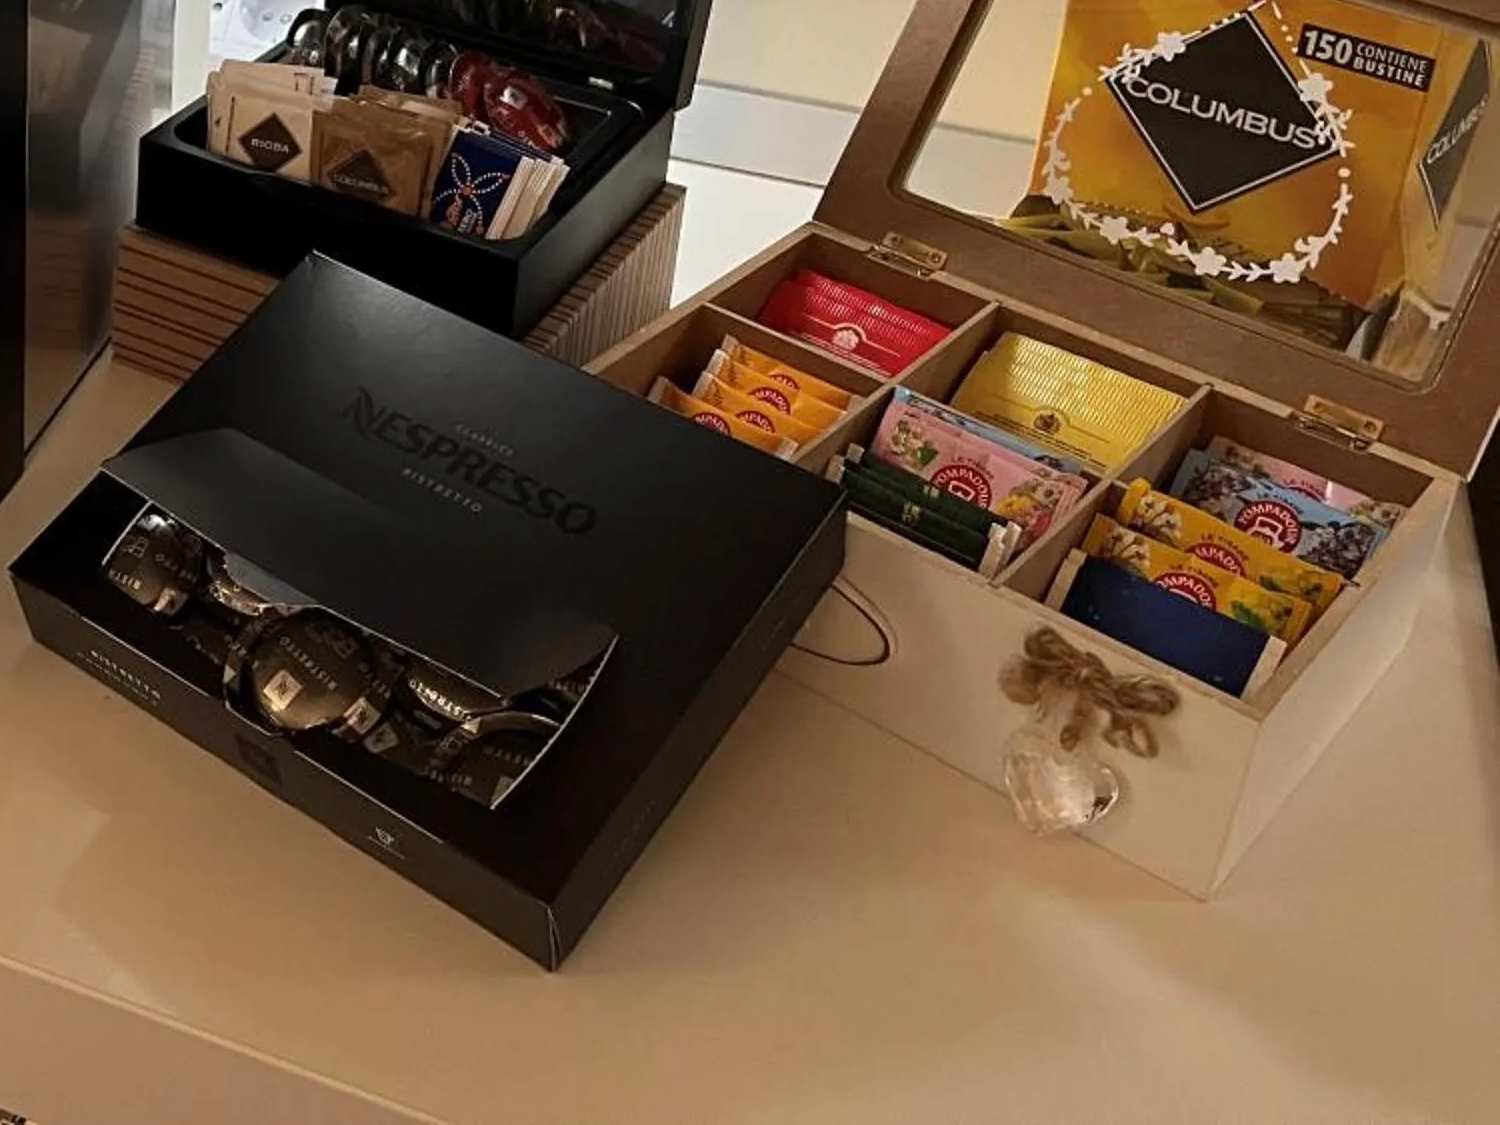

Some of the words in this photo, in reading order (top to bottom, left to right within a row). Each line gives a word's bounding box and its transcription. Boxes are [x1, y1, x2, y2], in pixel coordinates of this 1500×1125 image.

[1303, 28, 1354, 65] 150
[1355, 41, 1429, 74] CONTIENE
[1352, 56, 1426, 87] BUSTINE
[1125, 76, 1319, 150] COLUMBUS
[340, 384, 598, 535] NESPRESSO
[1236, 500, 1299, 546] POMPADOUR
